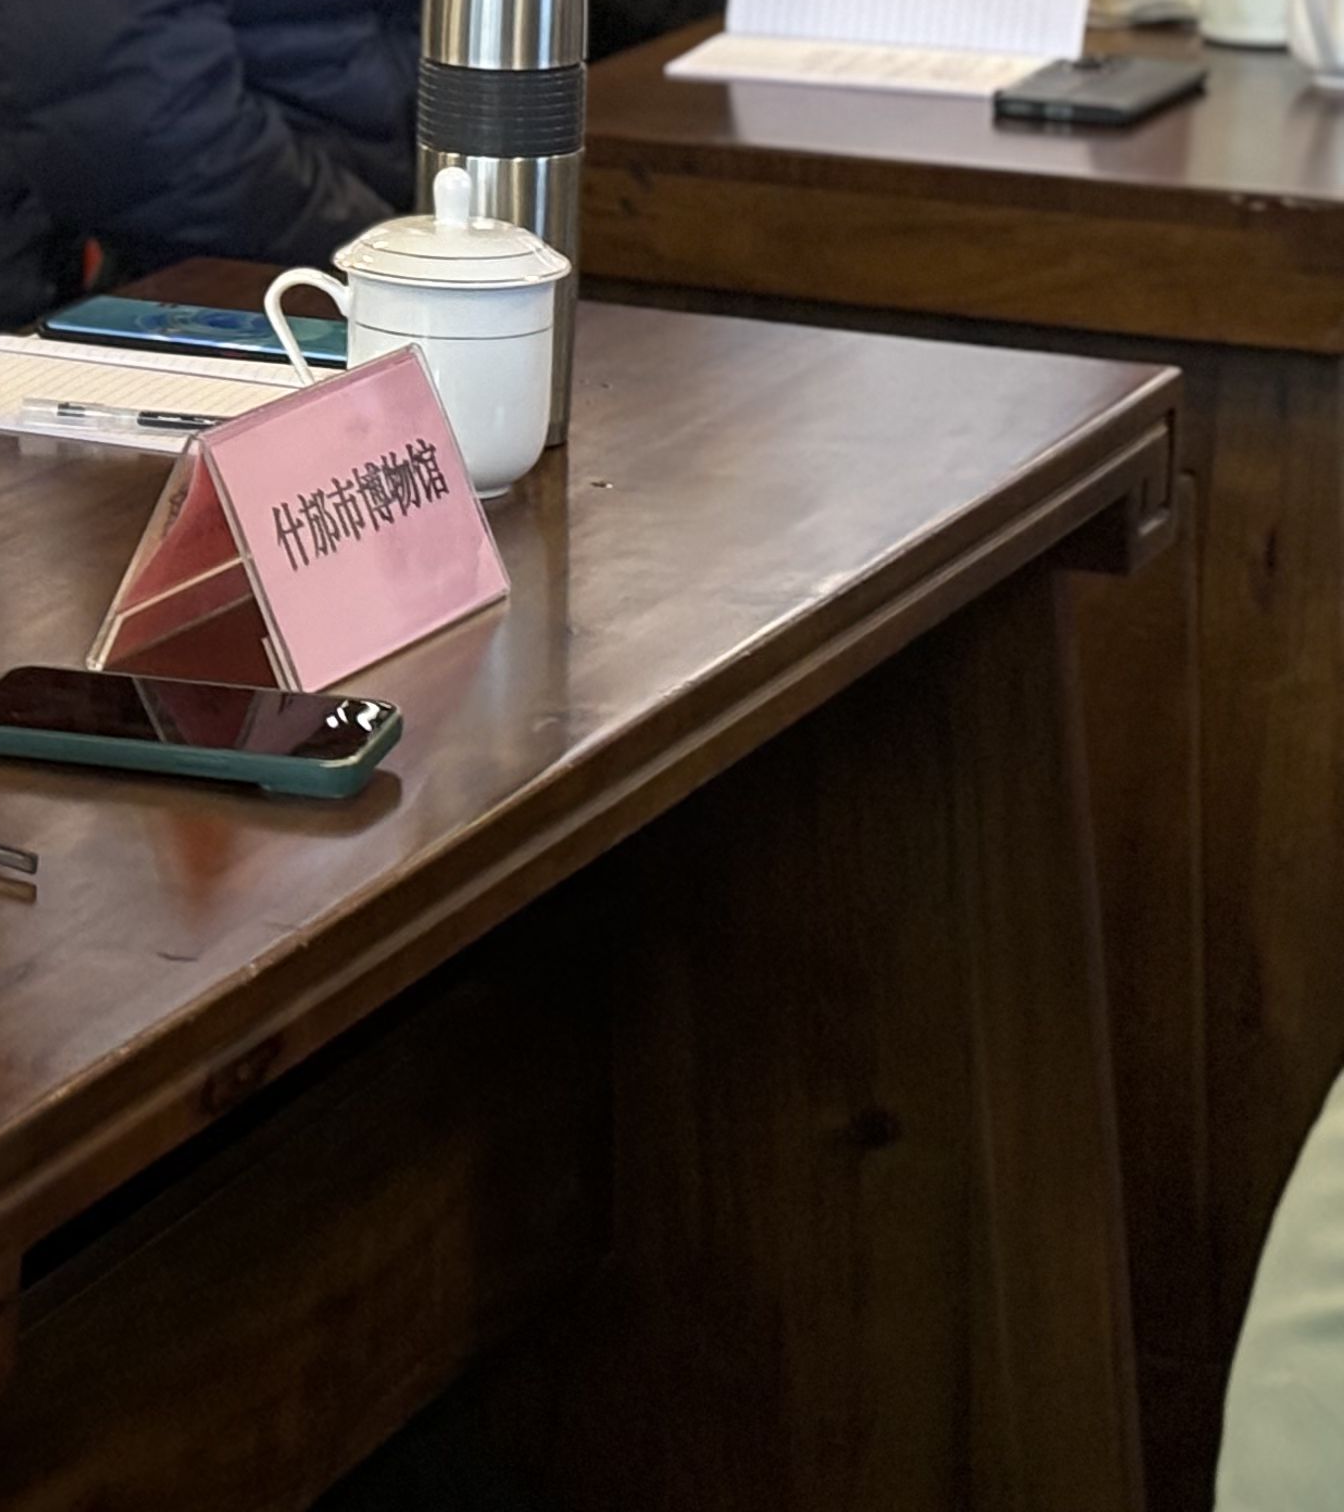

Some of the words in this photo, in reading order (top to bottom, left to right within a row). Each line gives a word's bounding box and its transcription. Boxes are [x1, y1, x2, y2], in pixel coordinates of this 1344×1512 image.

[272, 438, 449, 571] 什邡市博物馆
